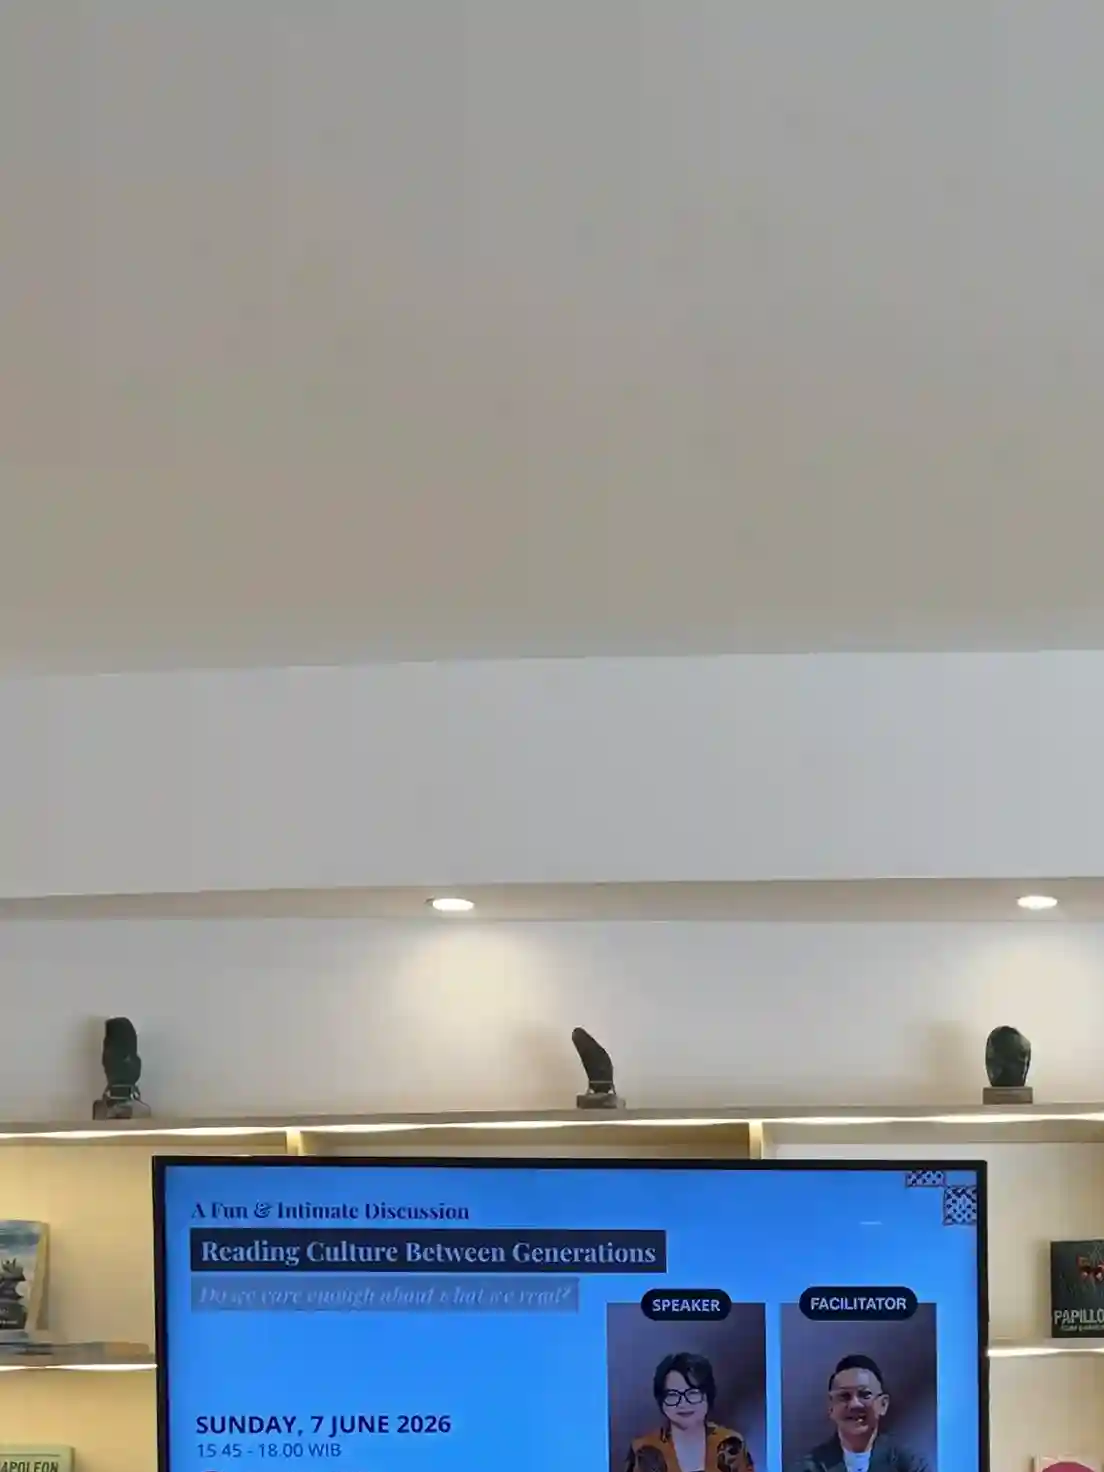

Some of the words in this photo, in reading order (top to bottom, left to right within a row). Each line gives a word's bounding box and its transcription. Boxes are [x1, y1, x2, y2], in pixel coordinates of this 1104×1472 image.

[191, 1203, 206, 1219] A
[212, 1202, 248, 1219] Fun
[254, 1202, 272, 1219] &
[277, 1202, 359, 1220] Intimate
[365, 1203, 469, 1221] Discussion
[201, 1241, 300, 1266] Reading
[307, 1241, 398, 1262] Culture
[405, 1242, 505, 1262] Between
[513, 1242, 656, 1263] Generations
[652, 1299, 721, 1312] SPEAKER
[810, 1296, 907, 1311] FACILITATOR
[196, 1415, 303, 1437] SUNDAY,
[311, 1415, 324, 1434] 7
[329, 1415, 390, 1437] JUNE
[397, 1415, 451, 1434] 2026
[259, 1443, 304, 1459] 18.00
[308, 1443, 342, 1458] WIB
